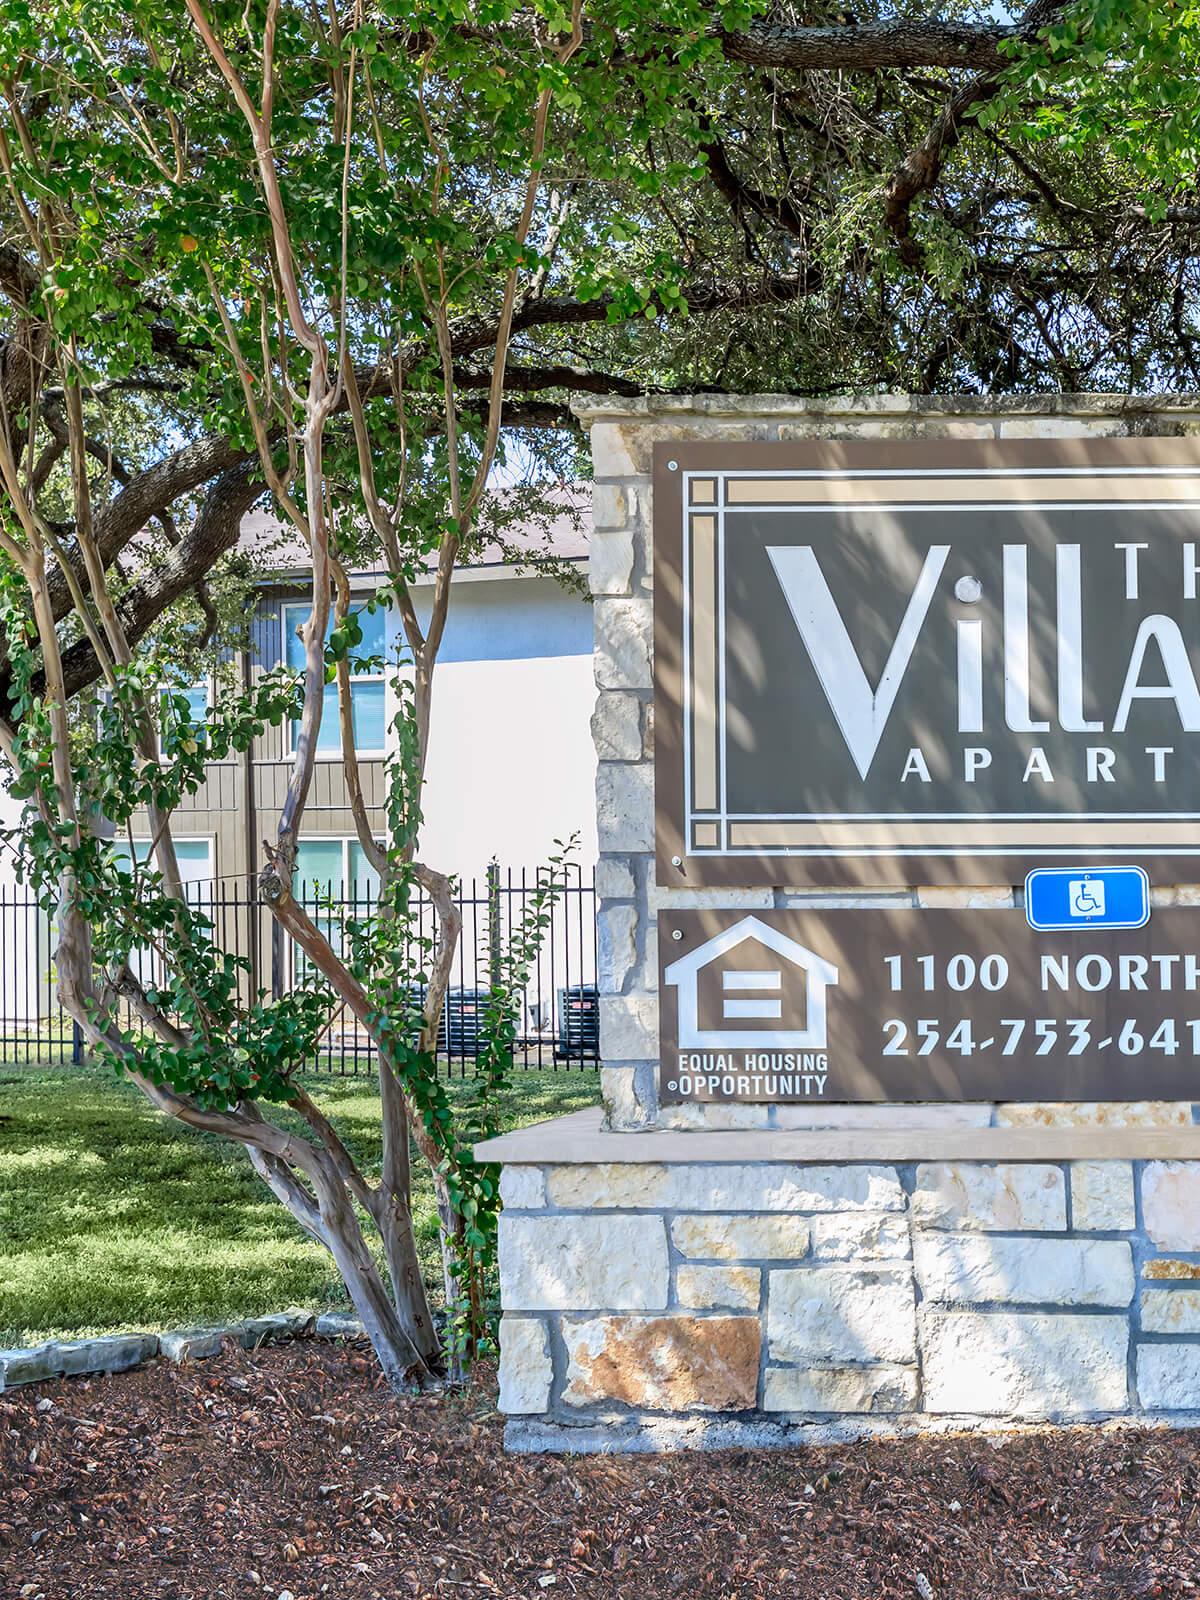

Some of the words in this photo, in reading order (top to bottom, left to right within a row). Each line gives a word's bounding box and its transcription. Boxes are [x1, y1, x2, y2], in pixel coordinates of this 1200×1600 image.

[883, 954, 1009, 992] 1100
[678, 1054, 738, 1073] EQUAL
[745, 1053, 828, 1072] HOUSING
[678, 1075, 828, 1096] OPPORTUNITY
